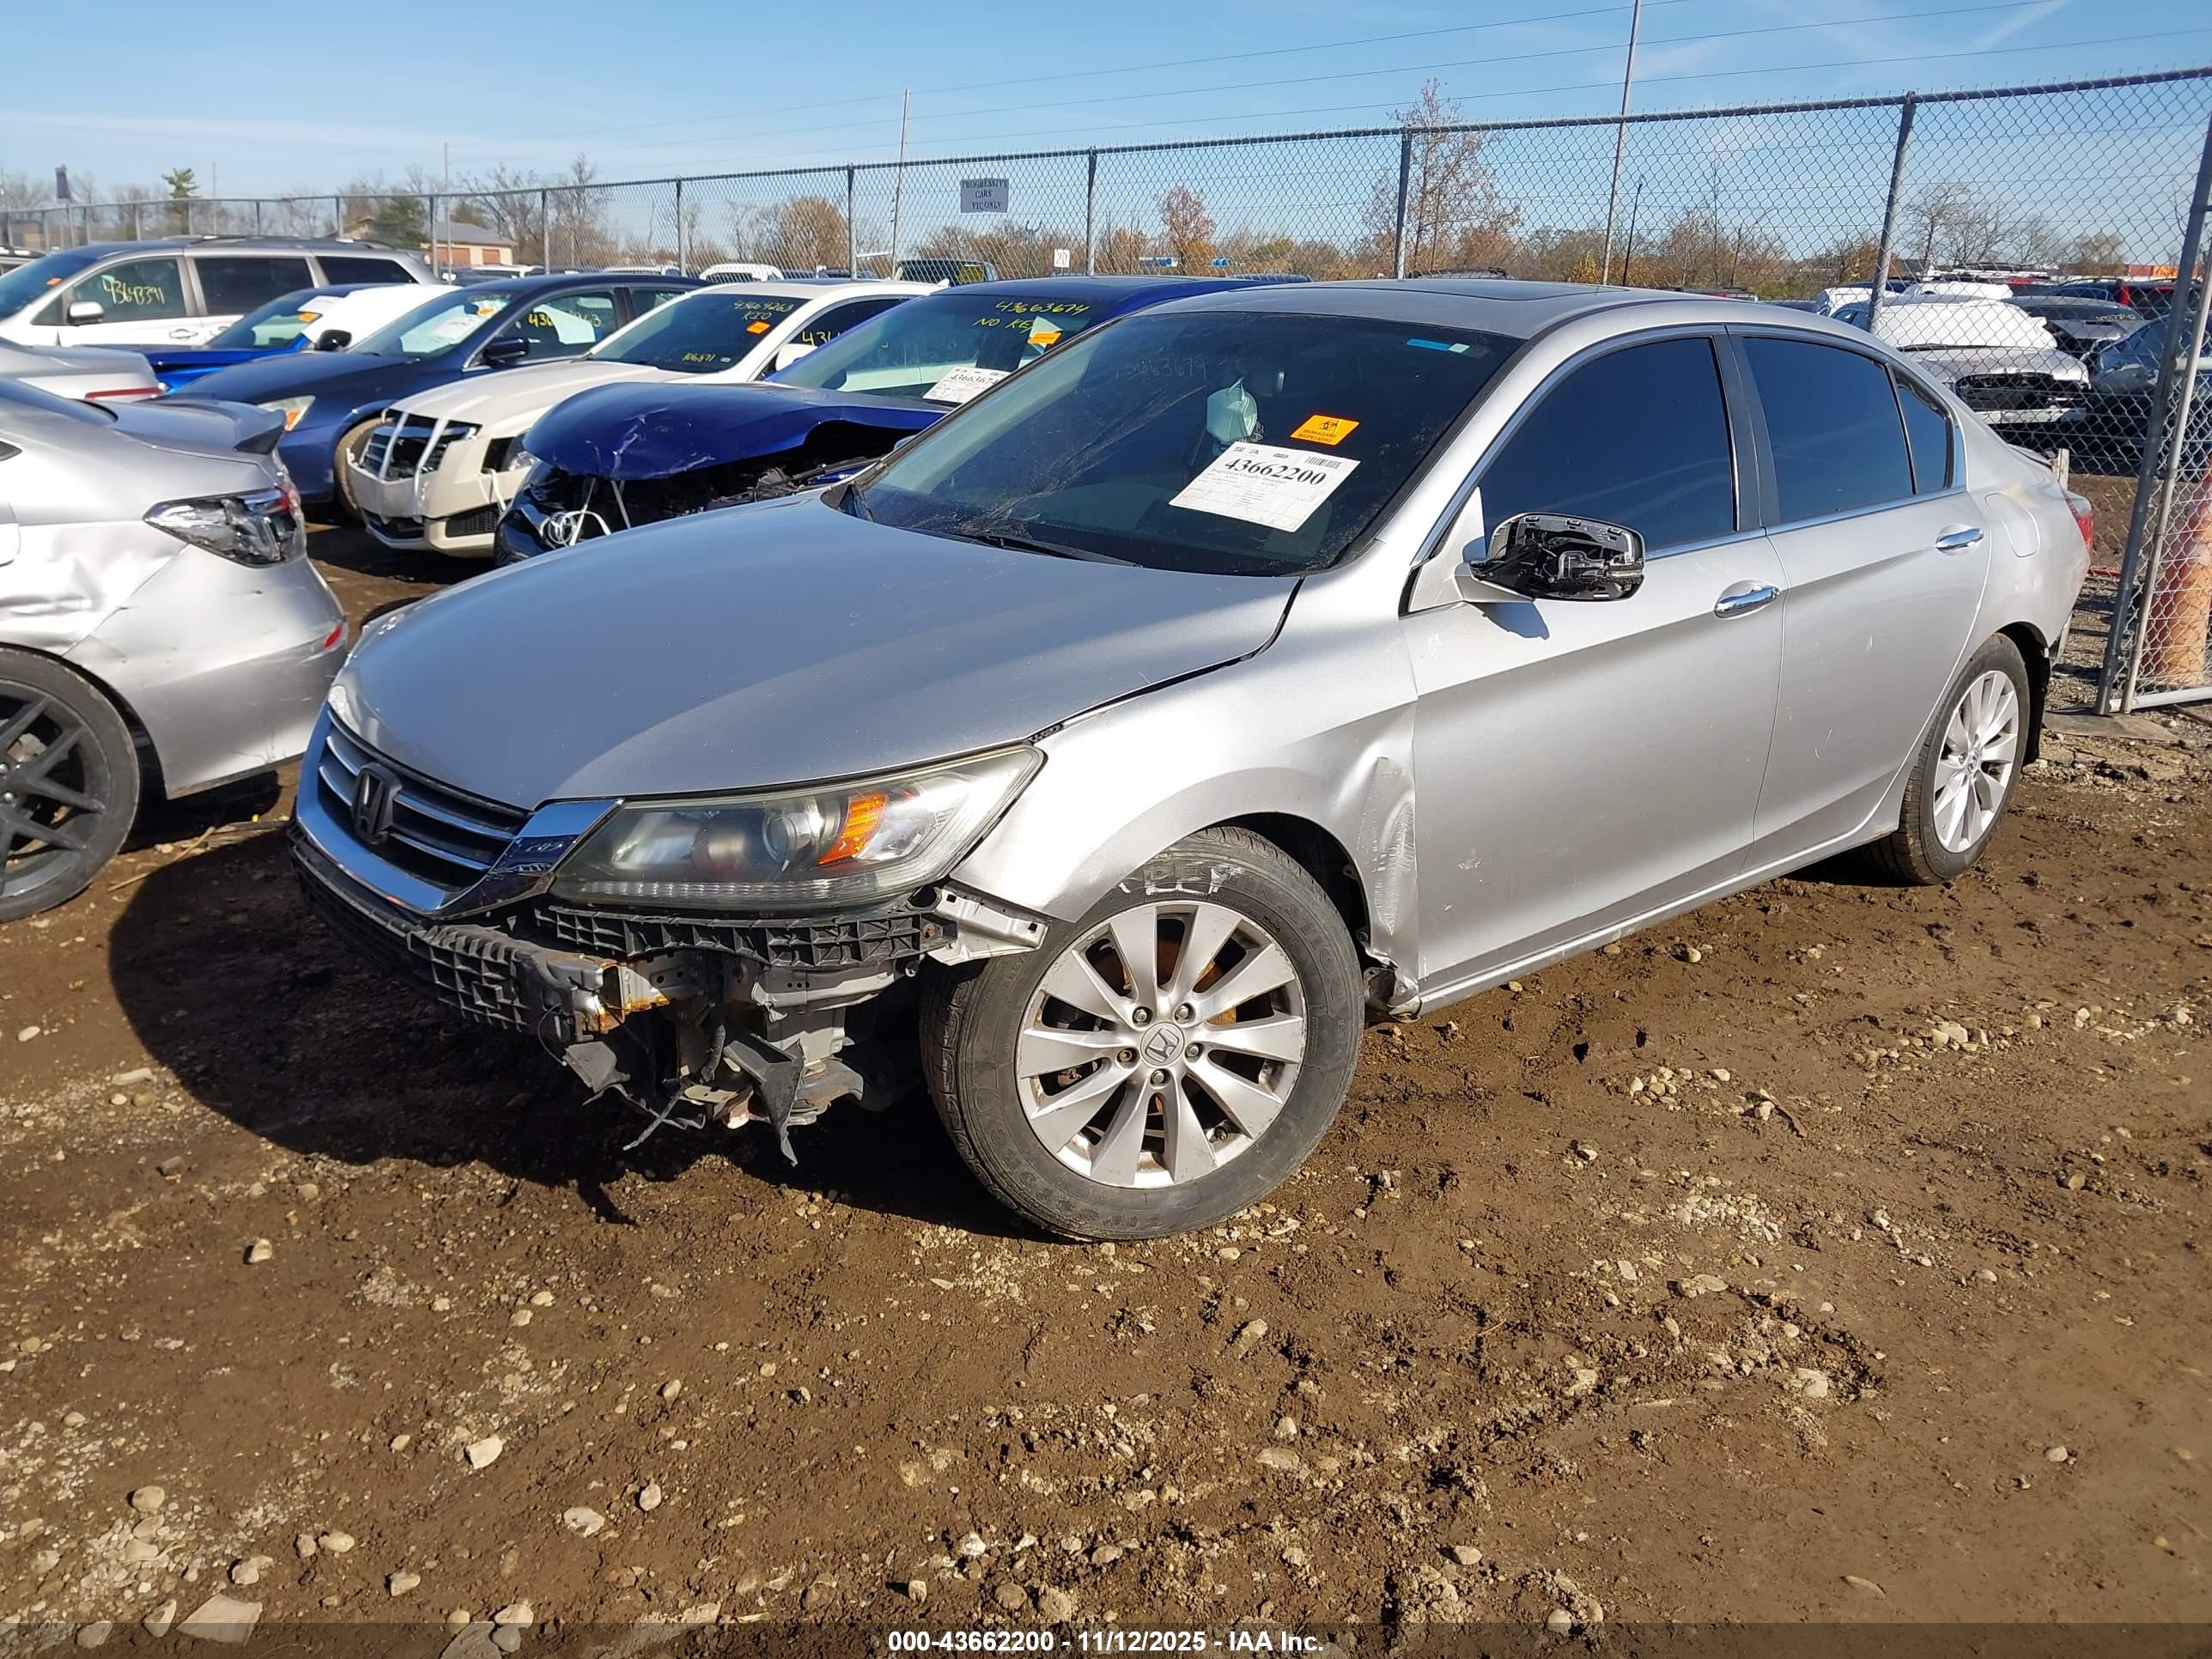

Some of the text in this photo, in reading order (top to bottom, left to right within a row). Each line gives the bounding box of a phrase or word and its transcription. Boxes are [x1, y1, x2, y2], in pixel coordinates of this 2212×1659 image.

[975, 190, 992, 198] CARS
[995, 301, 1091, 316] 43663674
[972, 318, 1000, 326] NO
[1224, 458, 1328, 486] 43662200
